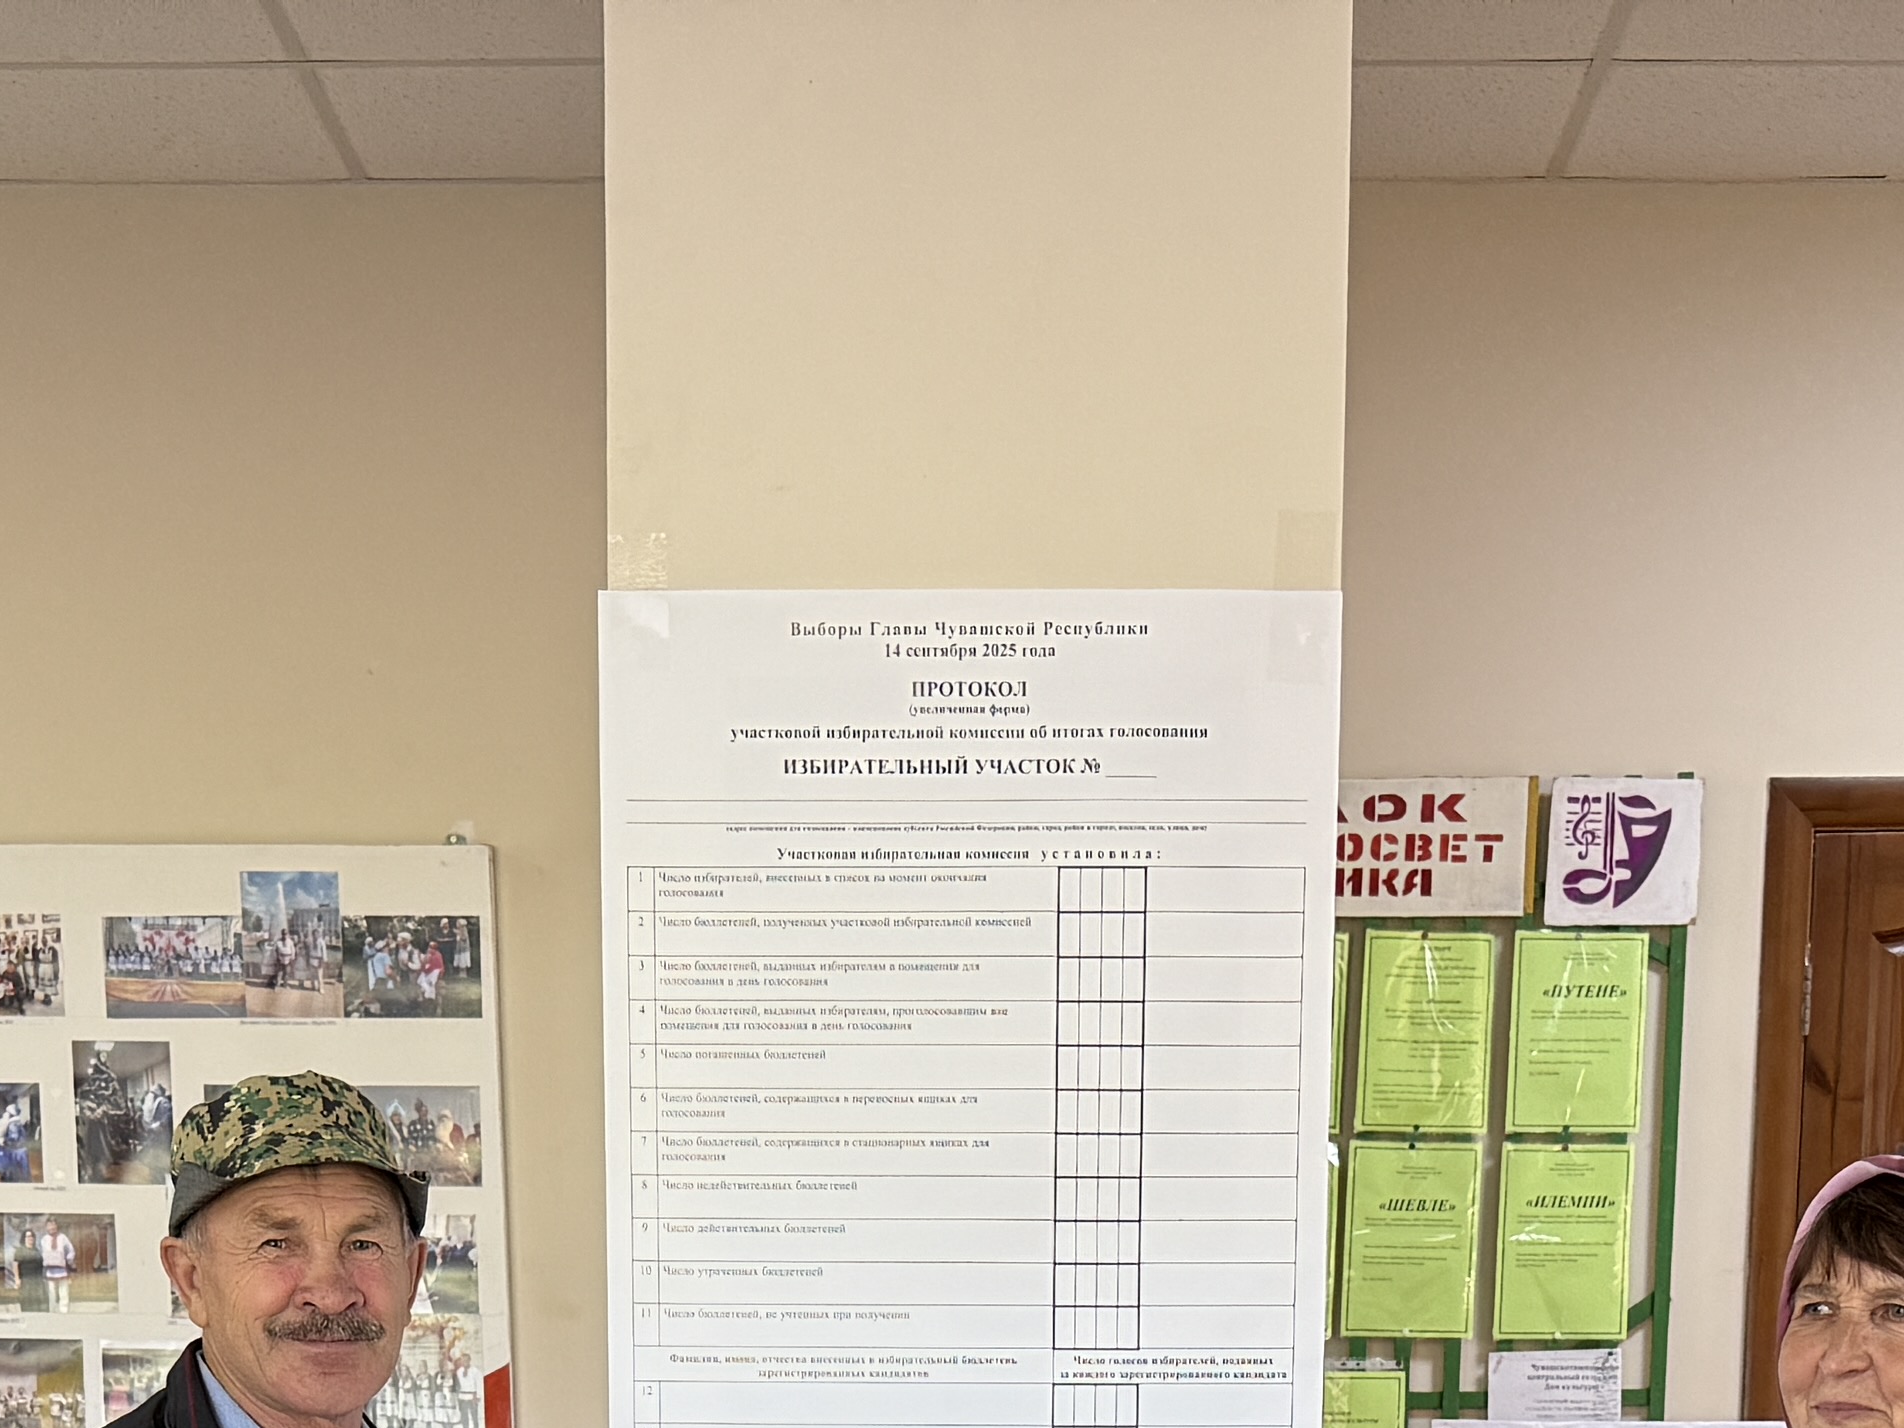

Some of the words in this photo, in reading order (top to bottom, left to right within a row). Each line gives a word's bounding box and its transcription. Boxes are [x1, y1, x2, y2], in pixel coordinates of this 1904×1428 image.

[791, 622, 862, 639] Выборы
[870, 621, 927, 636] Главы
[935, 621, 1035, 639] Чувашской
[1043, 621, 1148, 638] Республики
[885, 644, 901, 659] 14
[905, 641, 977, 661] сентября
[982, 644, 1017, 658] 2025
[1022, 645, 1056, 659] года
[912, 681, 1027, 697] ПРОТОКОЛ
[908, 703, 986, 716] (увеличенная
[988, 703, 1031, 716] форма)
[730, 725, 821, 742] участковой
[826, 725, 944, 742] избирательной
[949, 728, 1025, 739] комиссии
[1029, 724, 1047, 739] об
[1052, 728, 1104, 738] итогах
[1109, 727, 1208, 738] голосования
[784, 755, 968, 775] ИЗБИРАТЕЛЬНЫЙ
[975, 758, 1076, 774] УЧАСТОК
[1079, 758, 1101, 774] №
[1338, 793, 1468, 823] ОК
[777, 847, 857, 860] Участковая
[861, 847, 961, 862] избирательная
[965, 850, 1029, 860] комиссия
[639, 870, 643, 883] 1
[638, 915, 644, 927] 2
[639, 959, 645, 971] 3
[638, 1004, 646, 1014] 4
[640, 1047, 646, 1060] 5
[639, 1092, 647, 1103] 6
[640, 1135, 647, 1146] 7
[641, 1179, 648, 1190] 8
[641, 1222, 649, 1233] 9
[640, 1265, 652, 1276] 10
[641, 1307, 651, 1319] 11
[642, 1385, 653, 1396] 12
